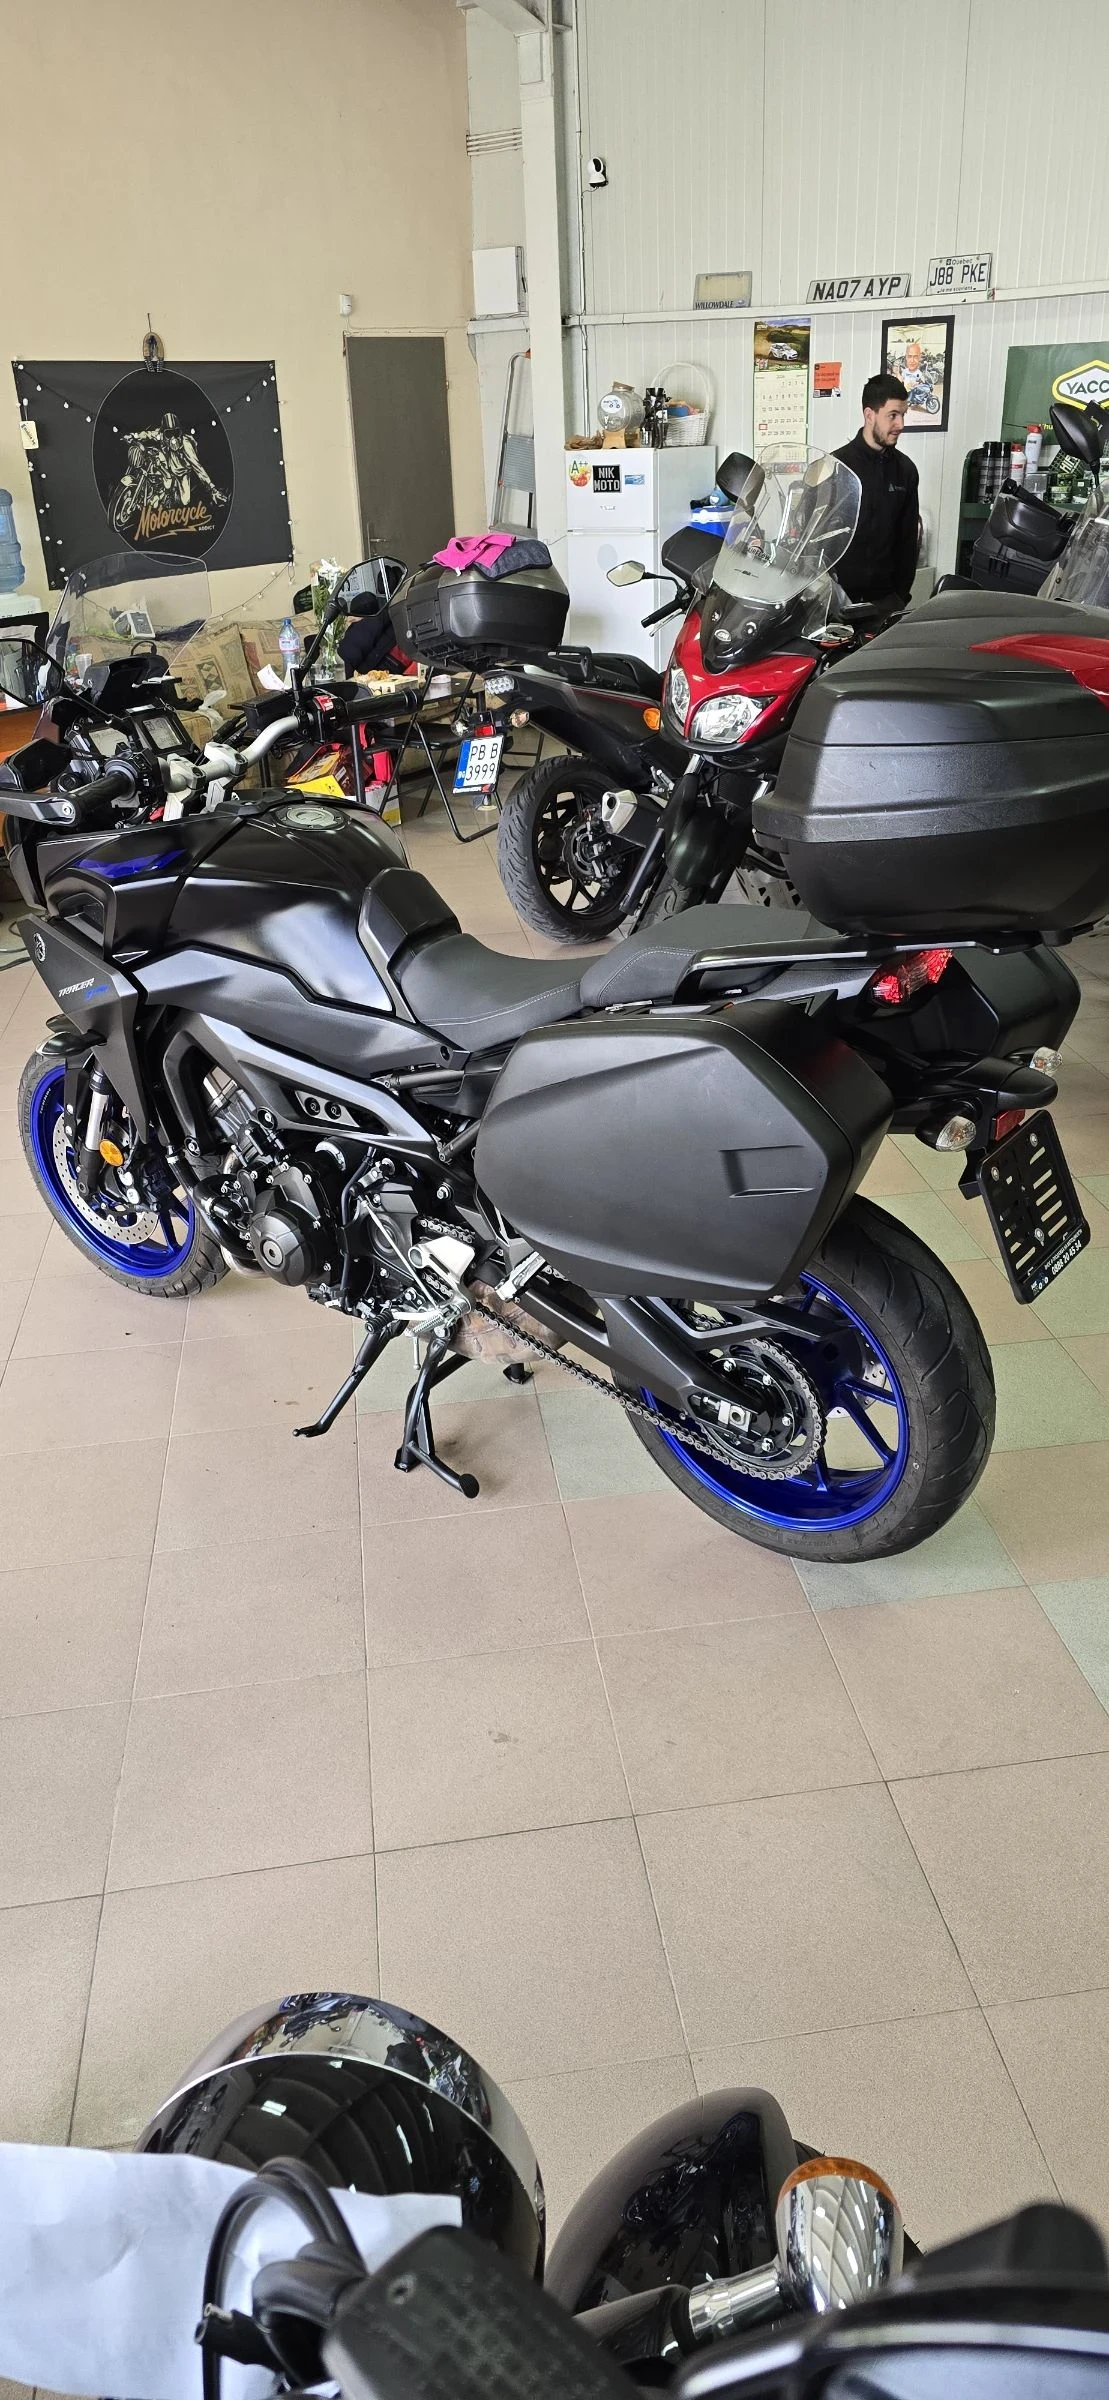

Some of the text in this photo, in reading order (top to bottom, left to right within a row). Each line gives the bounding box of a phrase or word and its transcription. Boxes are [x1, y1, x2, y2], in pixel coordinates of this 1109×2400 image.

[930, 262, 987, 286] J88 PKE
[864, 276, 902, 297] AYP
[695, 300, 734, 310] WILLOWDALE
[571, 460, 588, 474] A++
[598, 467, 615, 479] NIK
[594, 479, 620, 491] MOTO
[134, 501, 212, 541] Motorcycle
[470, 743, 498, 761] PB B
[466, 762, 496, 781] 3999
[58, 977, 95, 997] TRACER
